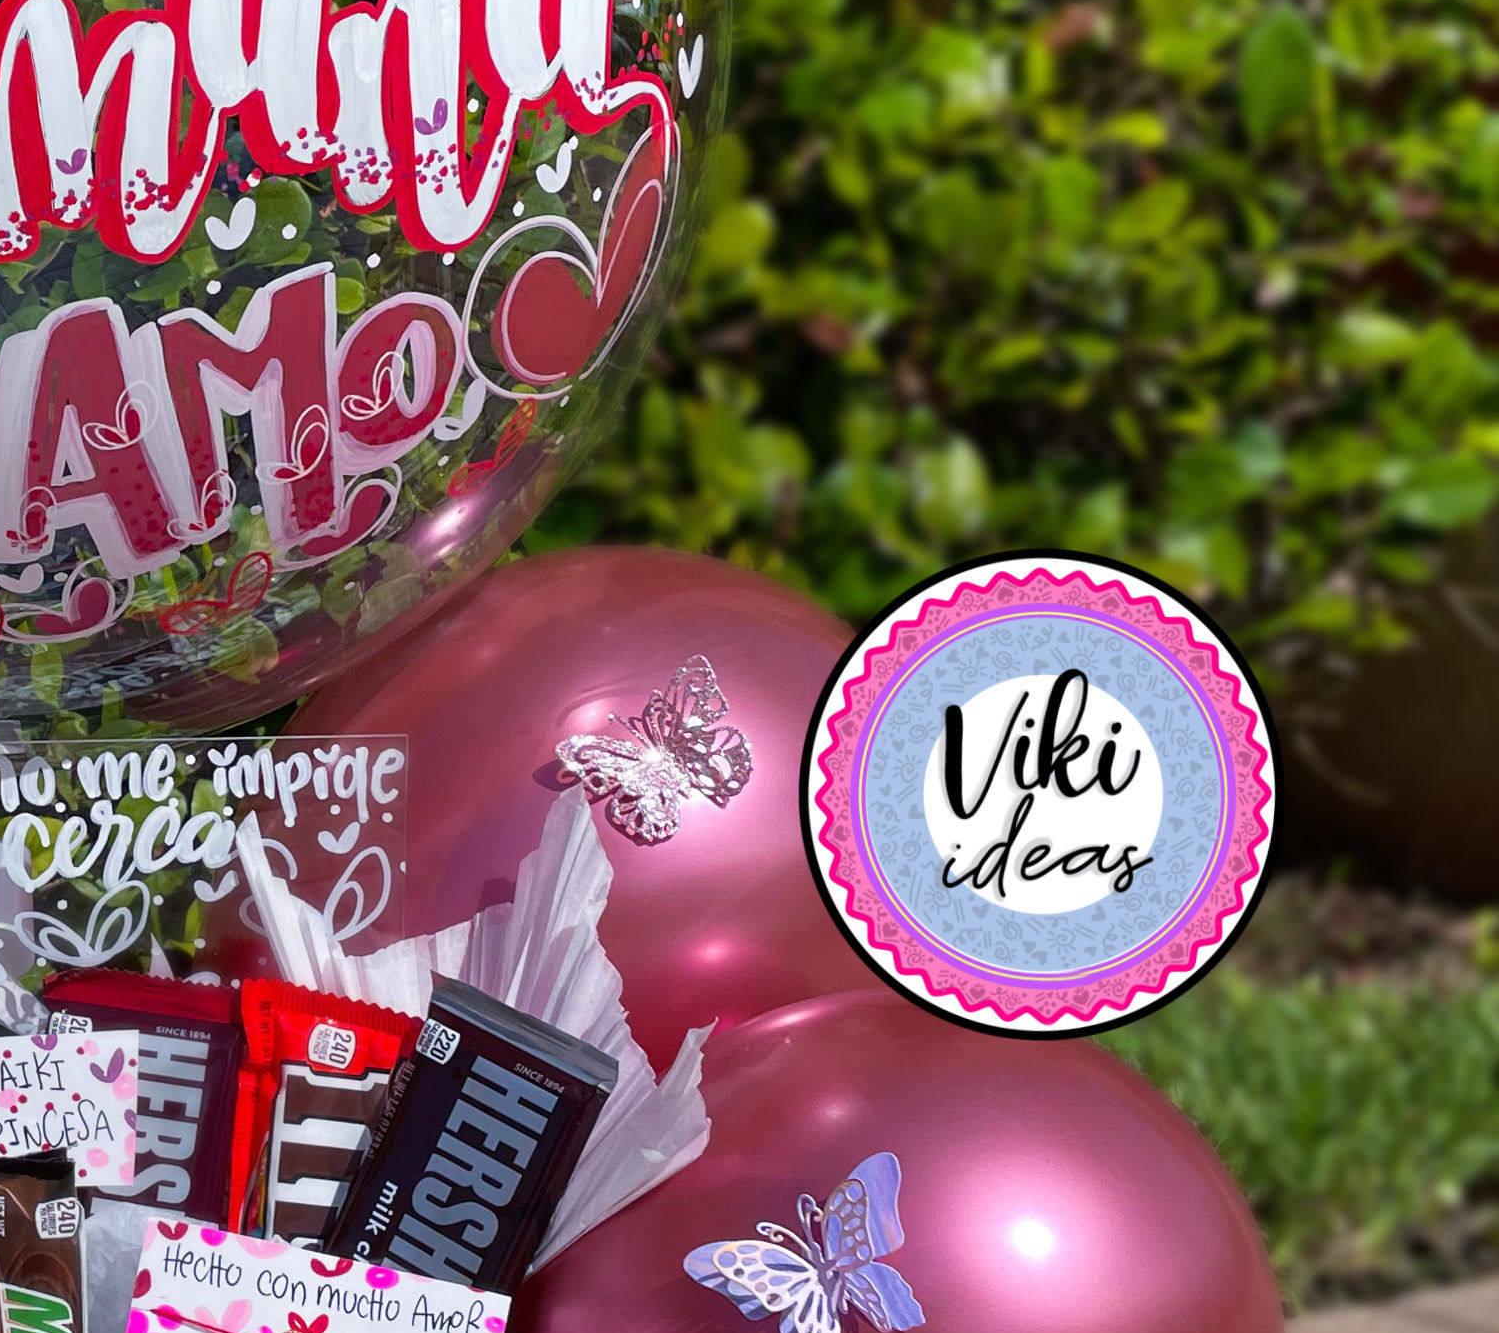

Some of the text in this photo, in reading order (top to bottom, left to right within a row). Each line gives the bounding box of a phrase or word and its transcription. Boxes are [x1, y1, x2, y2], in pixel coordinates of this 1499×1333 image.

[77, 743, 177, 803] me
[2, 799, 238, 894] cerca
[155, 1025, 213, 1041] SINCE 1894
[329, 1030, 352, 1065] 240
[430, 1028, 457, 1061] 220
[514, 1062, 567, 1095] SINCE 1894
[384, 1054, 560, 1287] HERSH
[55, 1199, 77, 1235] 240
[364, 1180, 399, 1236] milk
[256, 1270, 307, 1306] con
